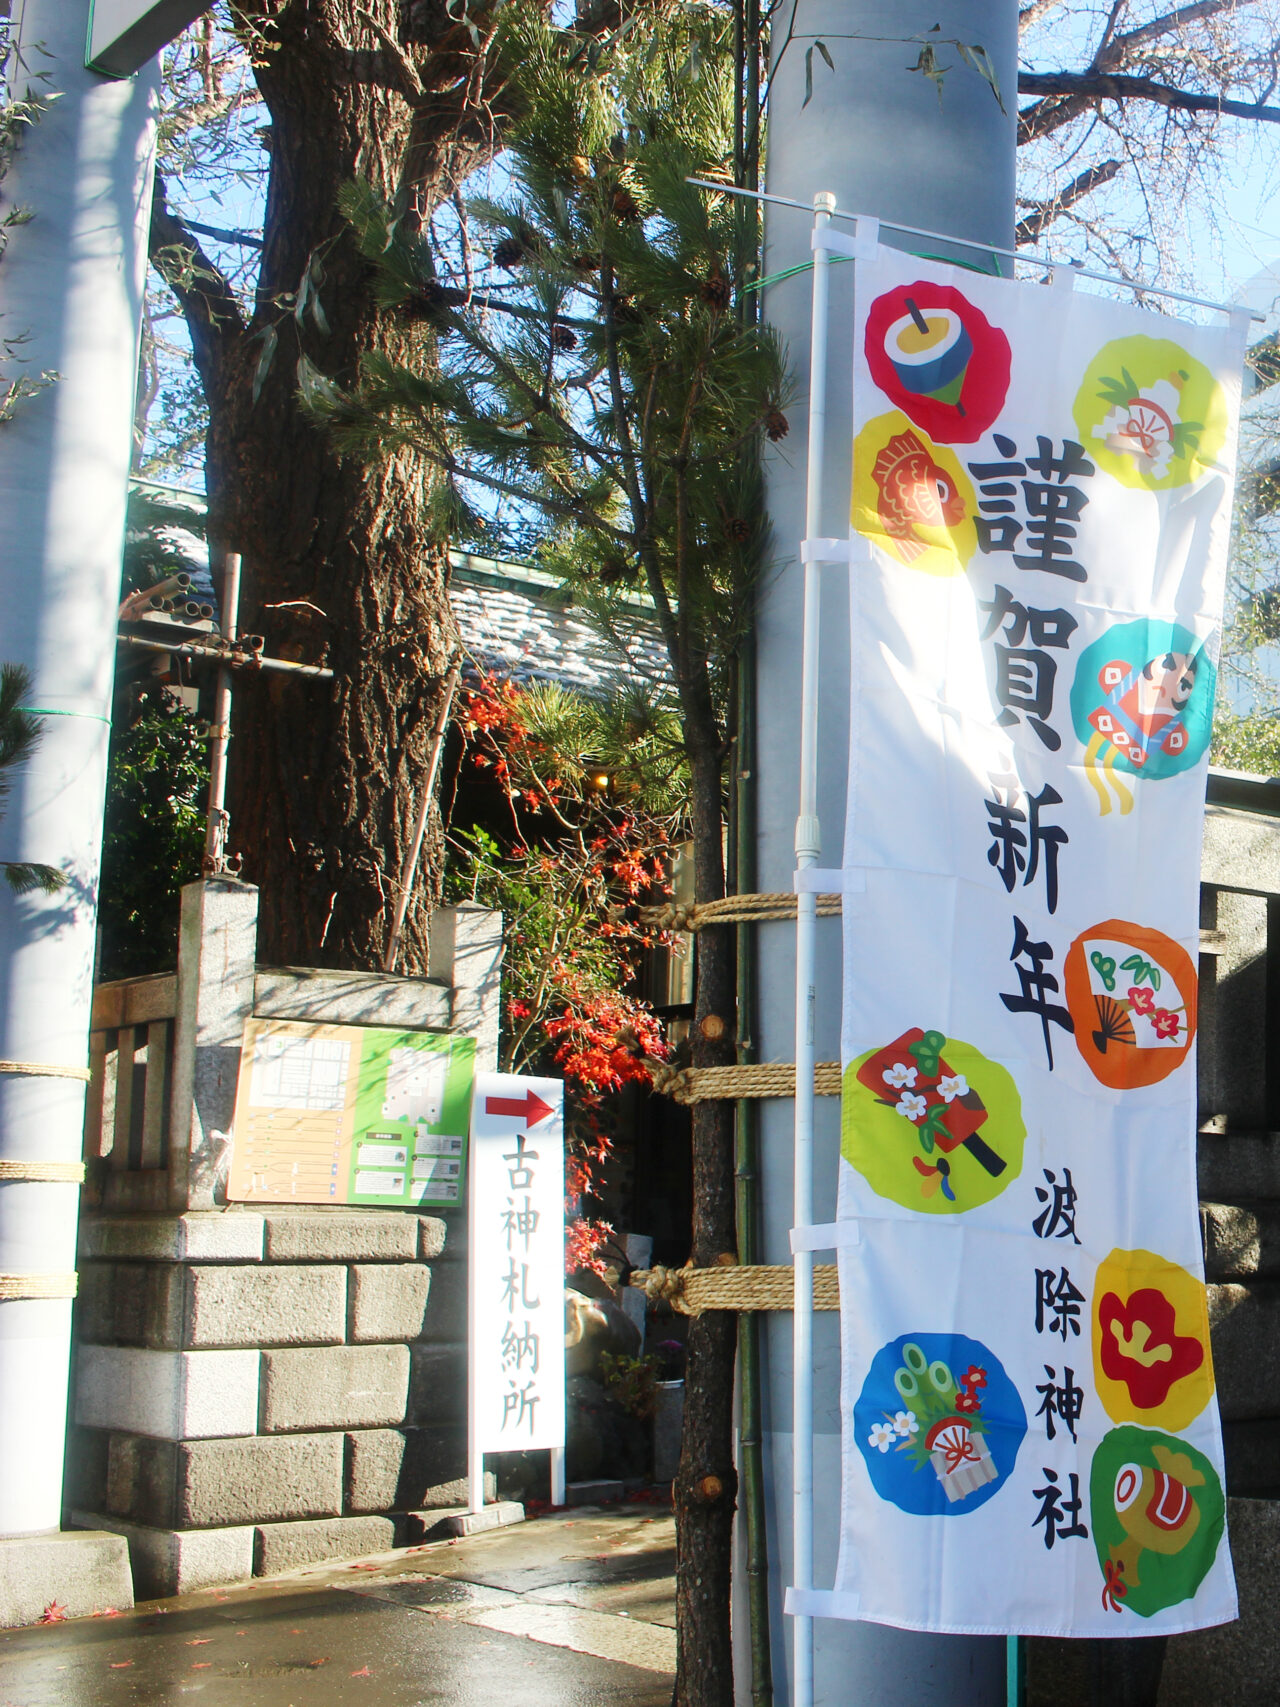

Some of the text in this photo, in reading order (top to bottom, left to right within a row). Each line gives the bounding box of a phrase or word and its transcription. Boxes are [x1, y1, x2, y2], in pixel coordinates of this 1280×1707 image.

[967, 433, 1097, 1072] 謹賀新年
[500, 1133, 541, 1438] 古神札納所
[1031, 1167, 1090, 1552] 波除神社
